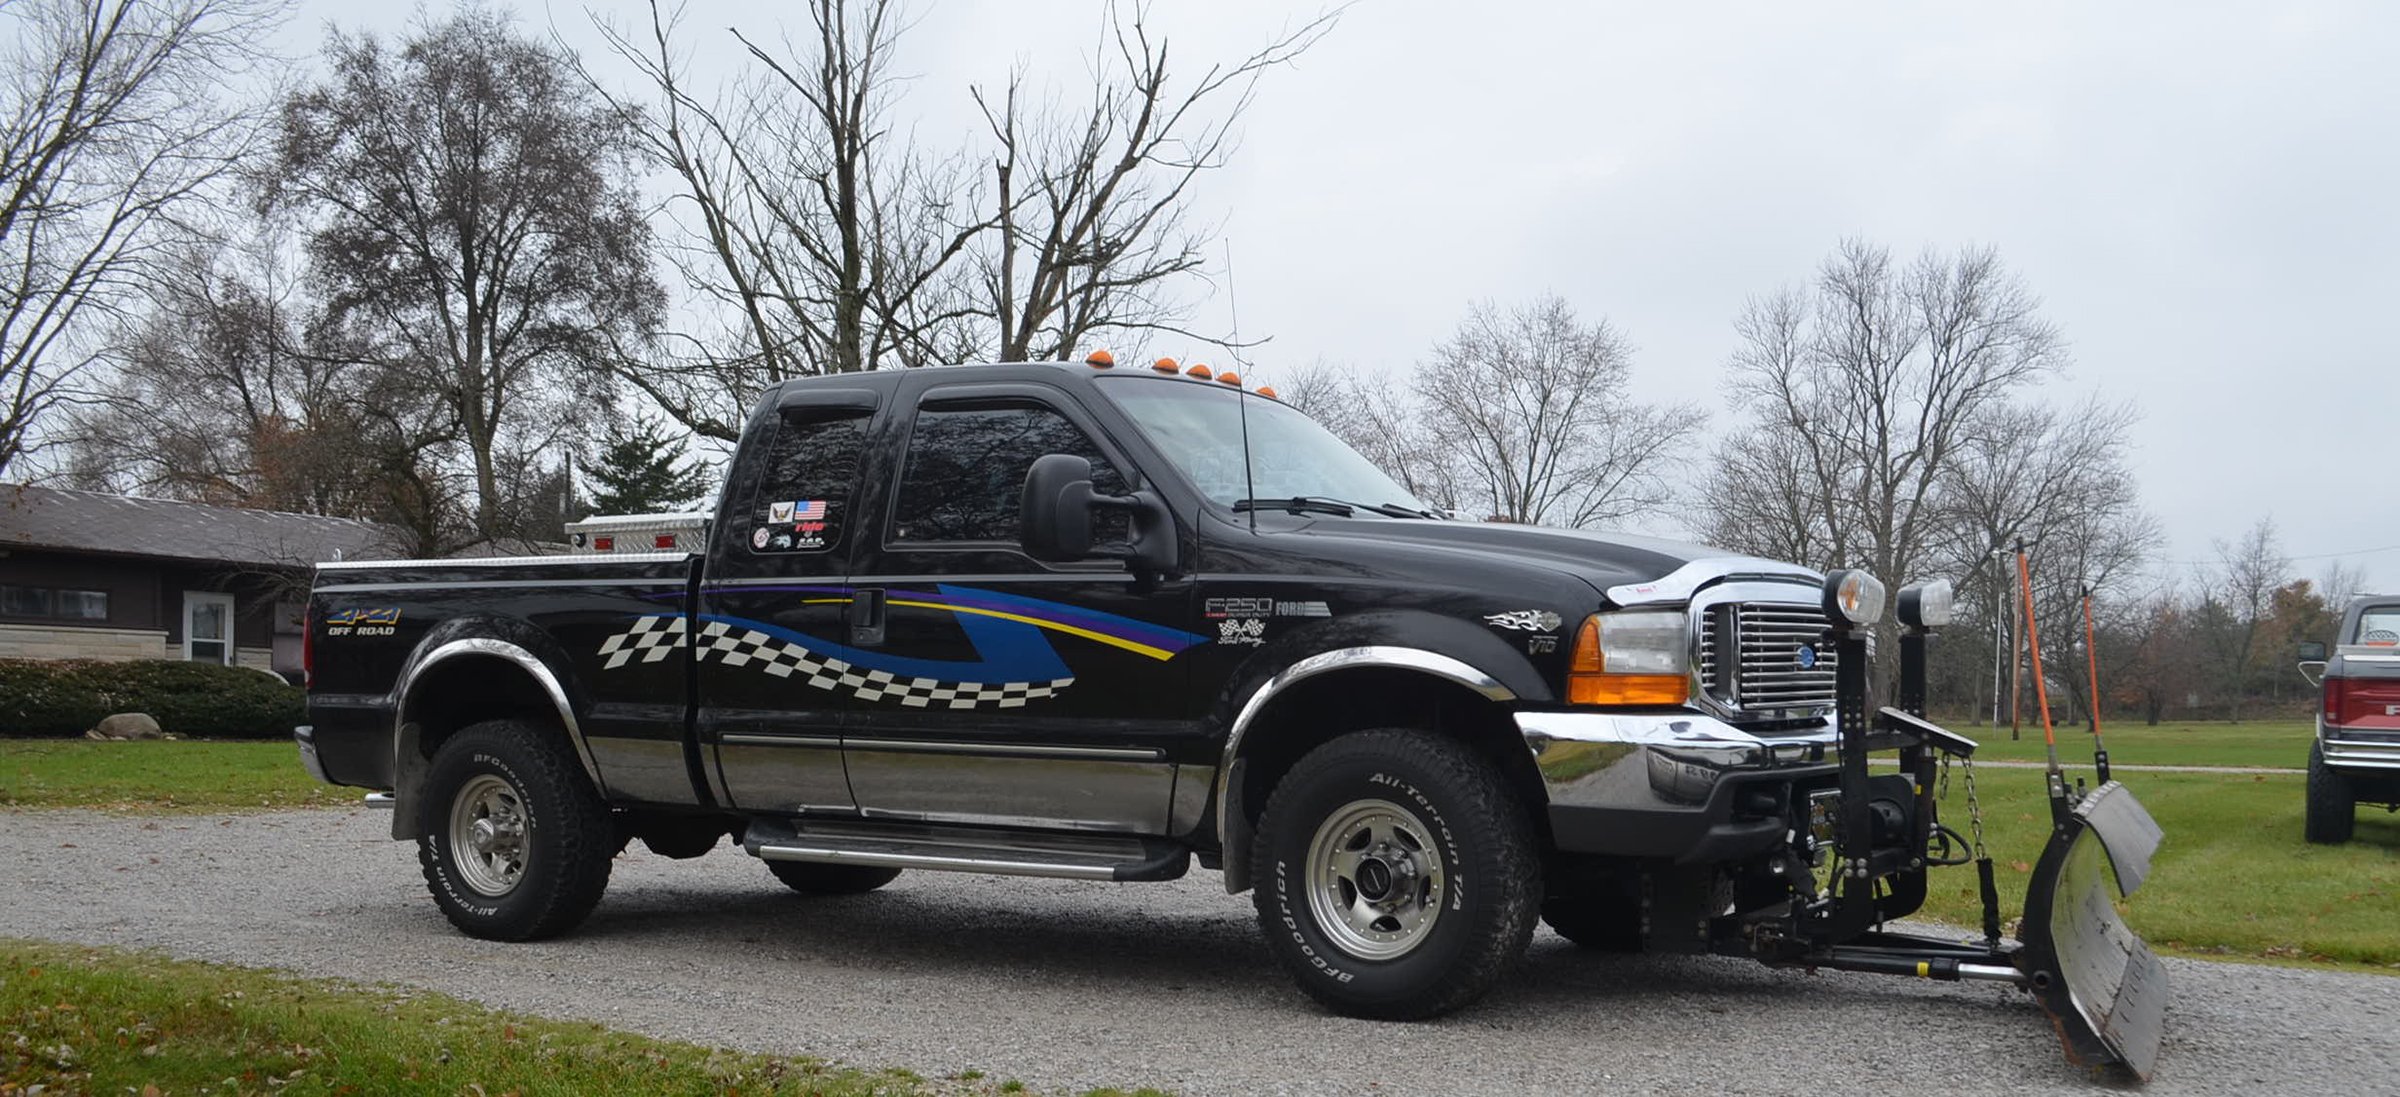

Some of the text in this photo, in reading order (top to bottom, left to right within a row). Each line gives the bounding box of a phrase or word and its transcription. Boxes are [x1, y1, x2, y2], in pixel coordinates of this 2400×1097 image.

[1205, 598, 1273, 612] F-250
[1276, 602, 1304, 616] FORD
[328, 627, 395, 636] OFF ROAD
[1369, 773, 1463, 910] All-Terrain T/A
[437, 867, 498, 915] All-Terrain
[1276, 861, 1354, 983] BFGoodrich
